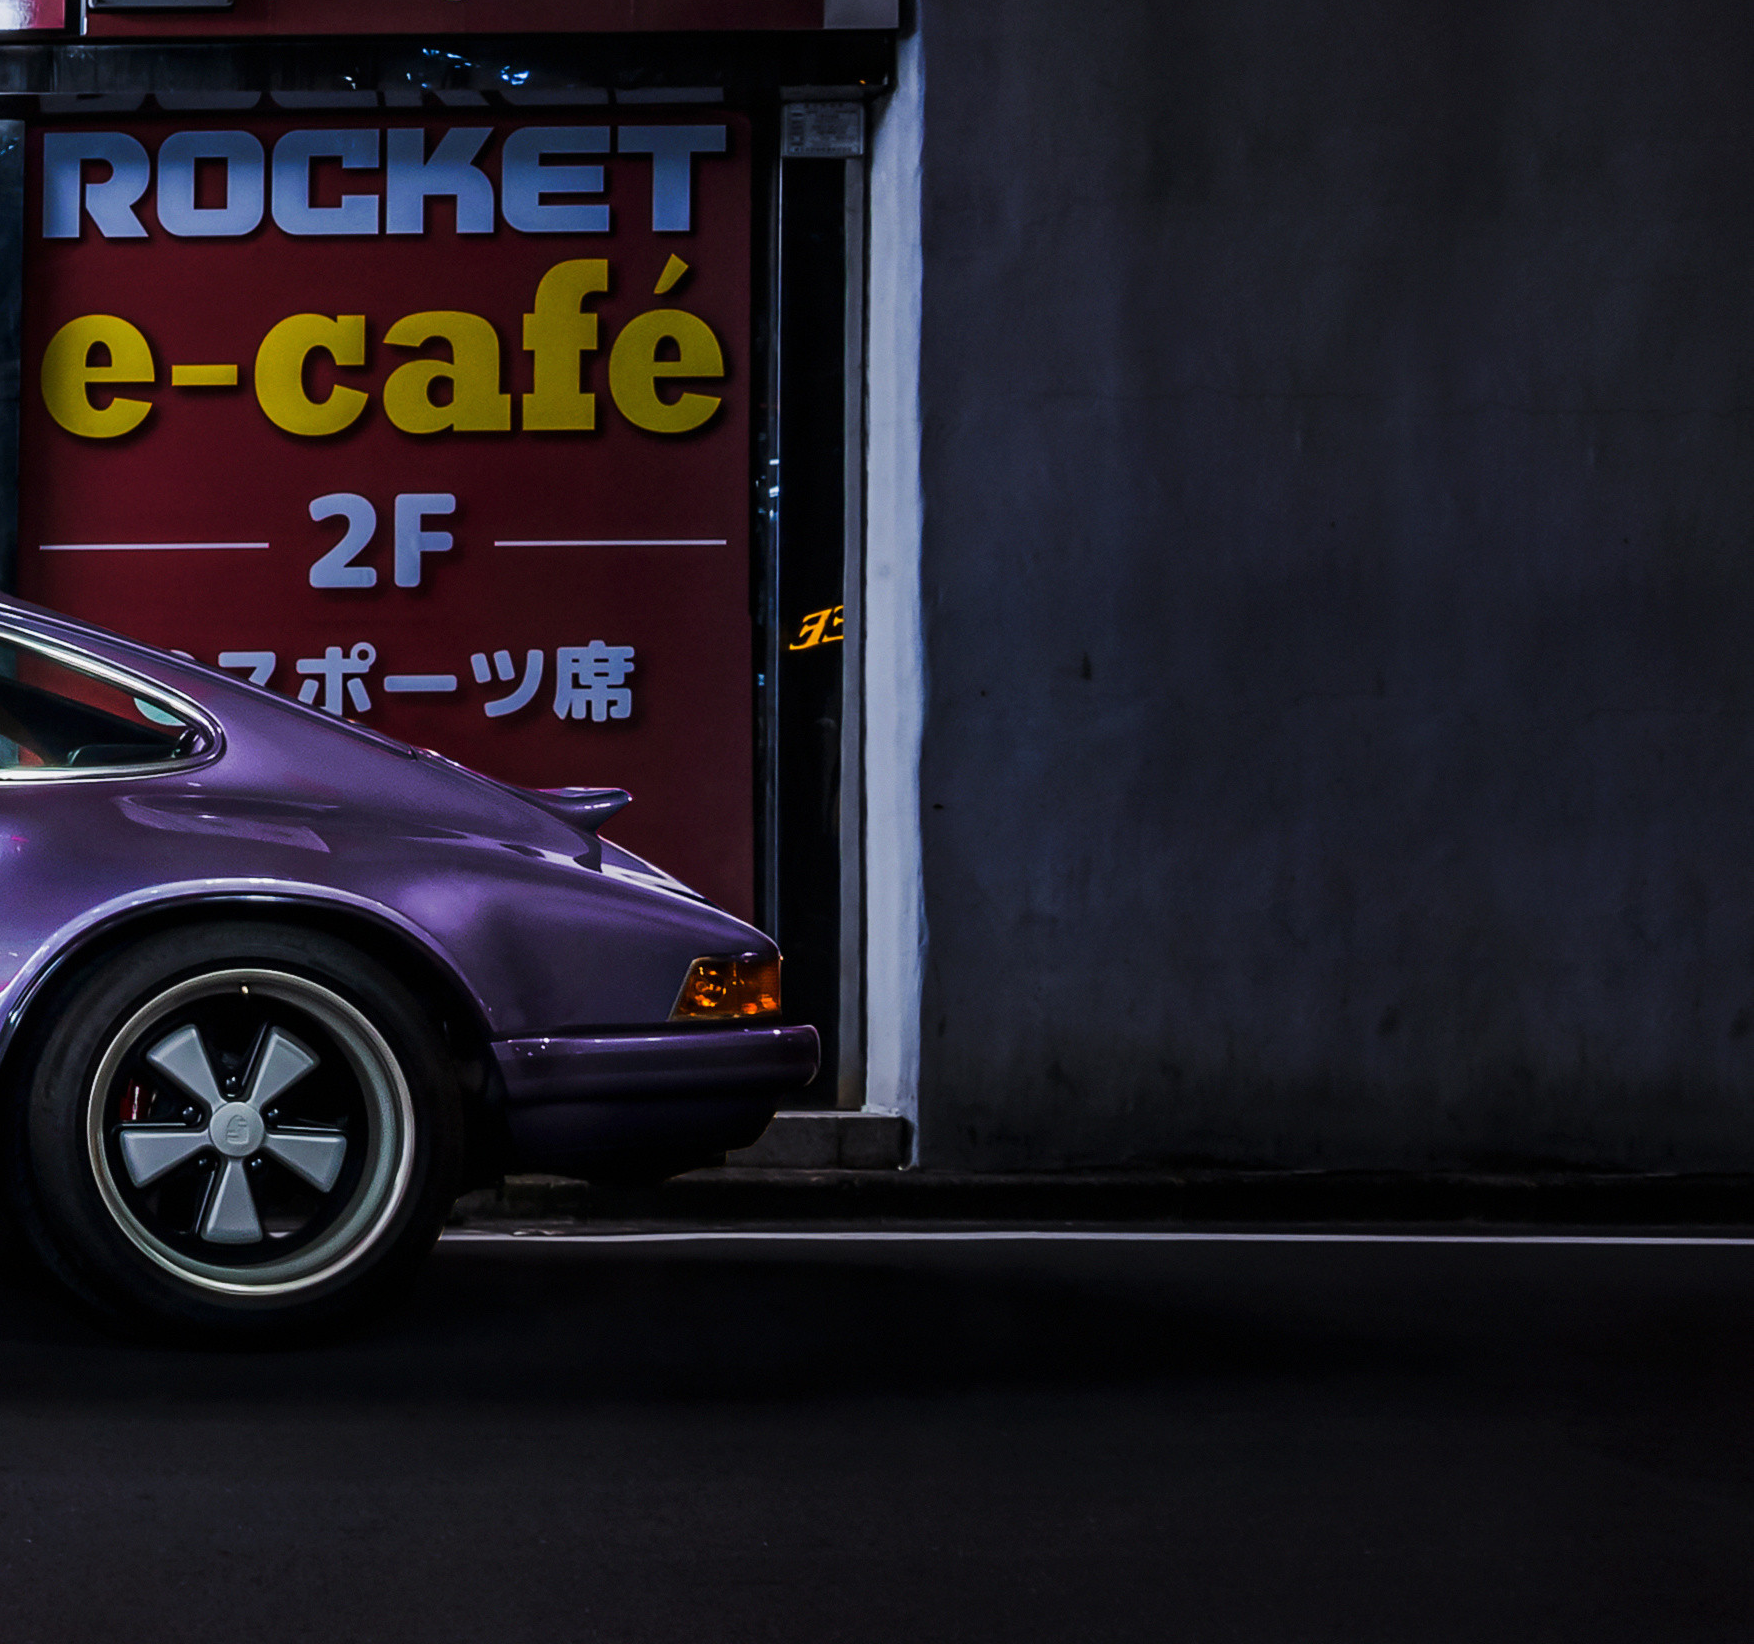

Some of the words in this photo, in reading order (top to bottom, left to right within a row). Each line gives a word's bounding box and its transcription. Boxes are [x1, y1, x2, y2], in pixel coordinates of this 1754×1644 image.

[42, 124, 727, 238] ROCKET
[41, 253, 726, 438] e-café
[308, 492, 456, 588] 2F
